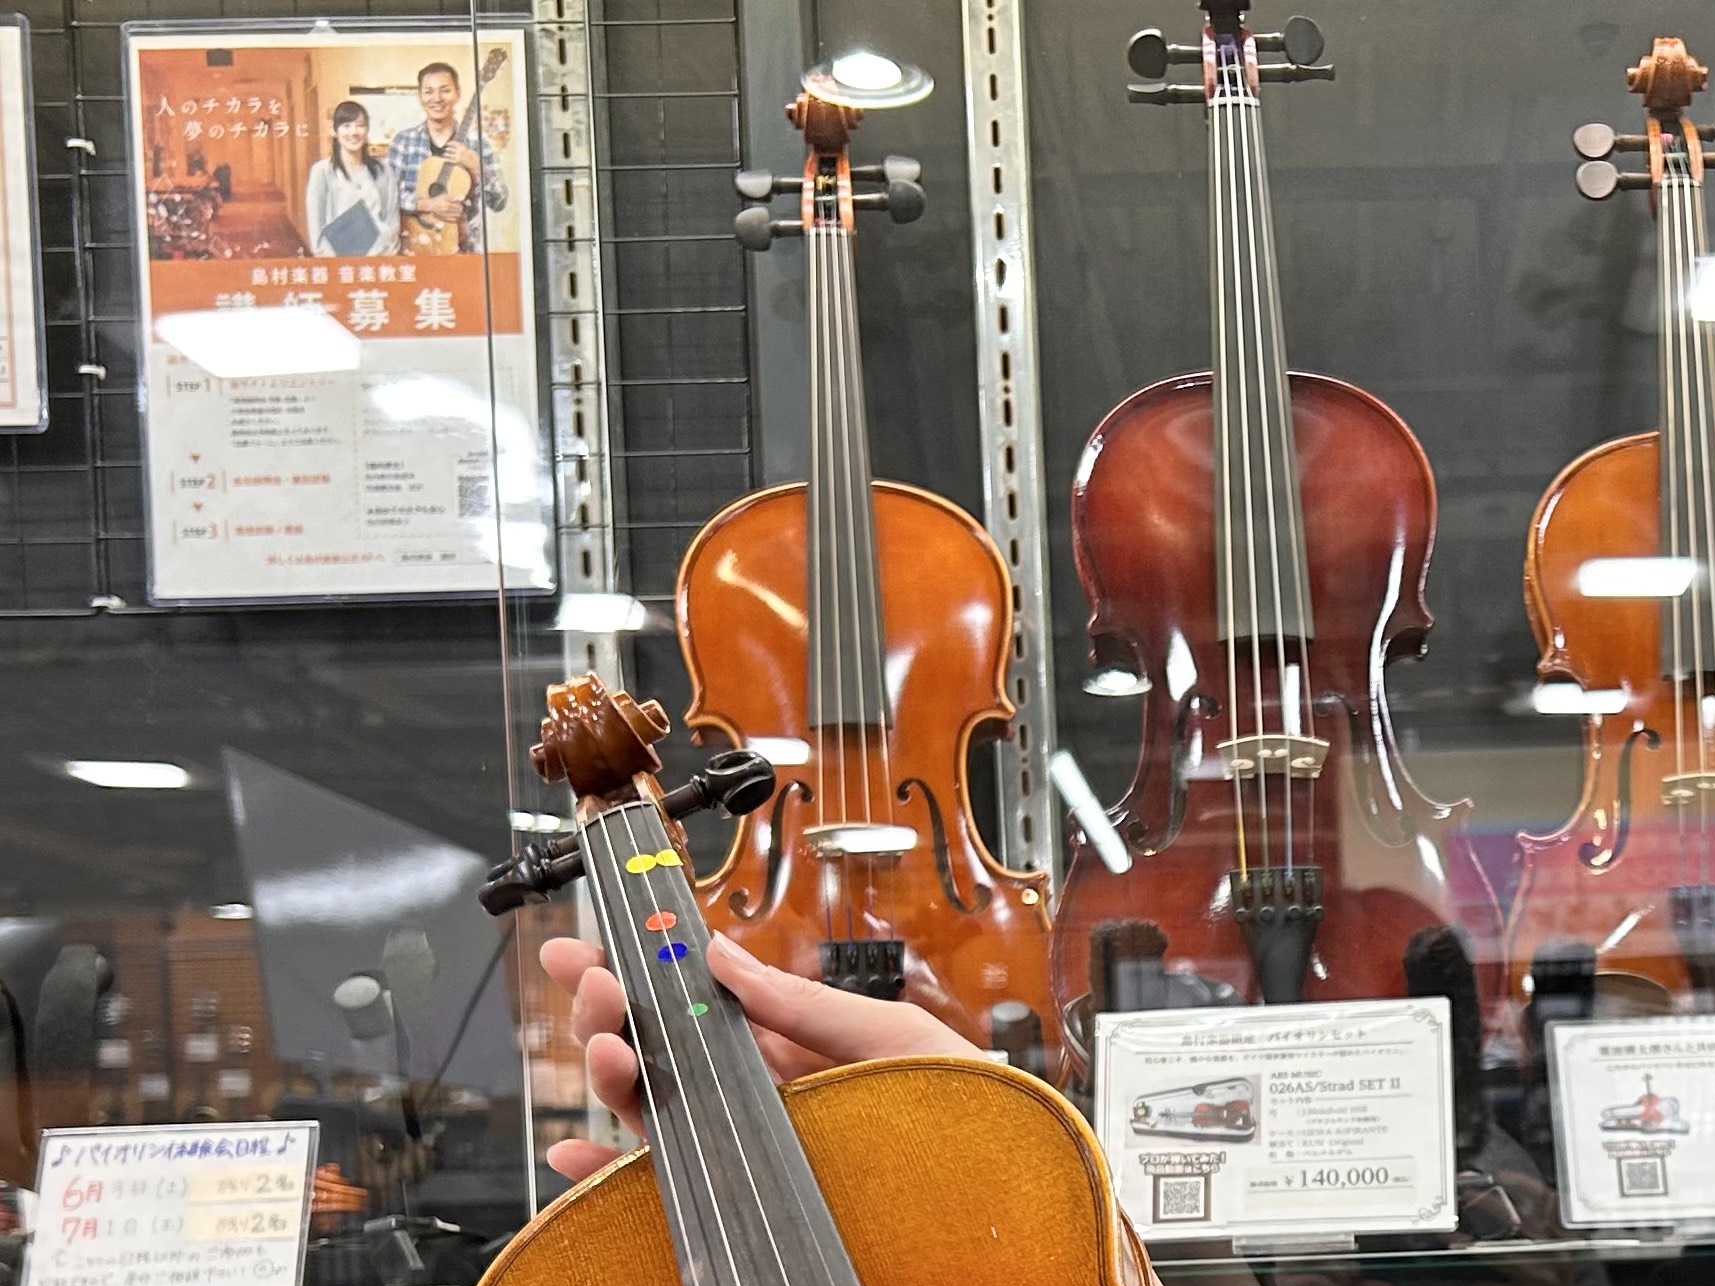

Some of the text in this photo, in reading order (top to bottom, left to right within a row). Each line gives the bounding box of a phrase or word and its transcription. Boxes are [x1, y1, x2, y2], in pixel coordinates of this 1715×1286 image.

[155, 95, 283, 117] 人のチカラを
[183, 119, 310, 141] 夢のチカラに
[251, 263, 418, 286] 島村楽器 音楽教室
[1269, 1079, 1355, 1095] 026AS/Strad
[1358, 1078, 1387, 1091] SET
[1284, 1167, 1389, 1188] ¥140,000
